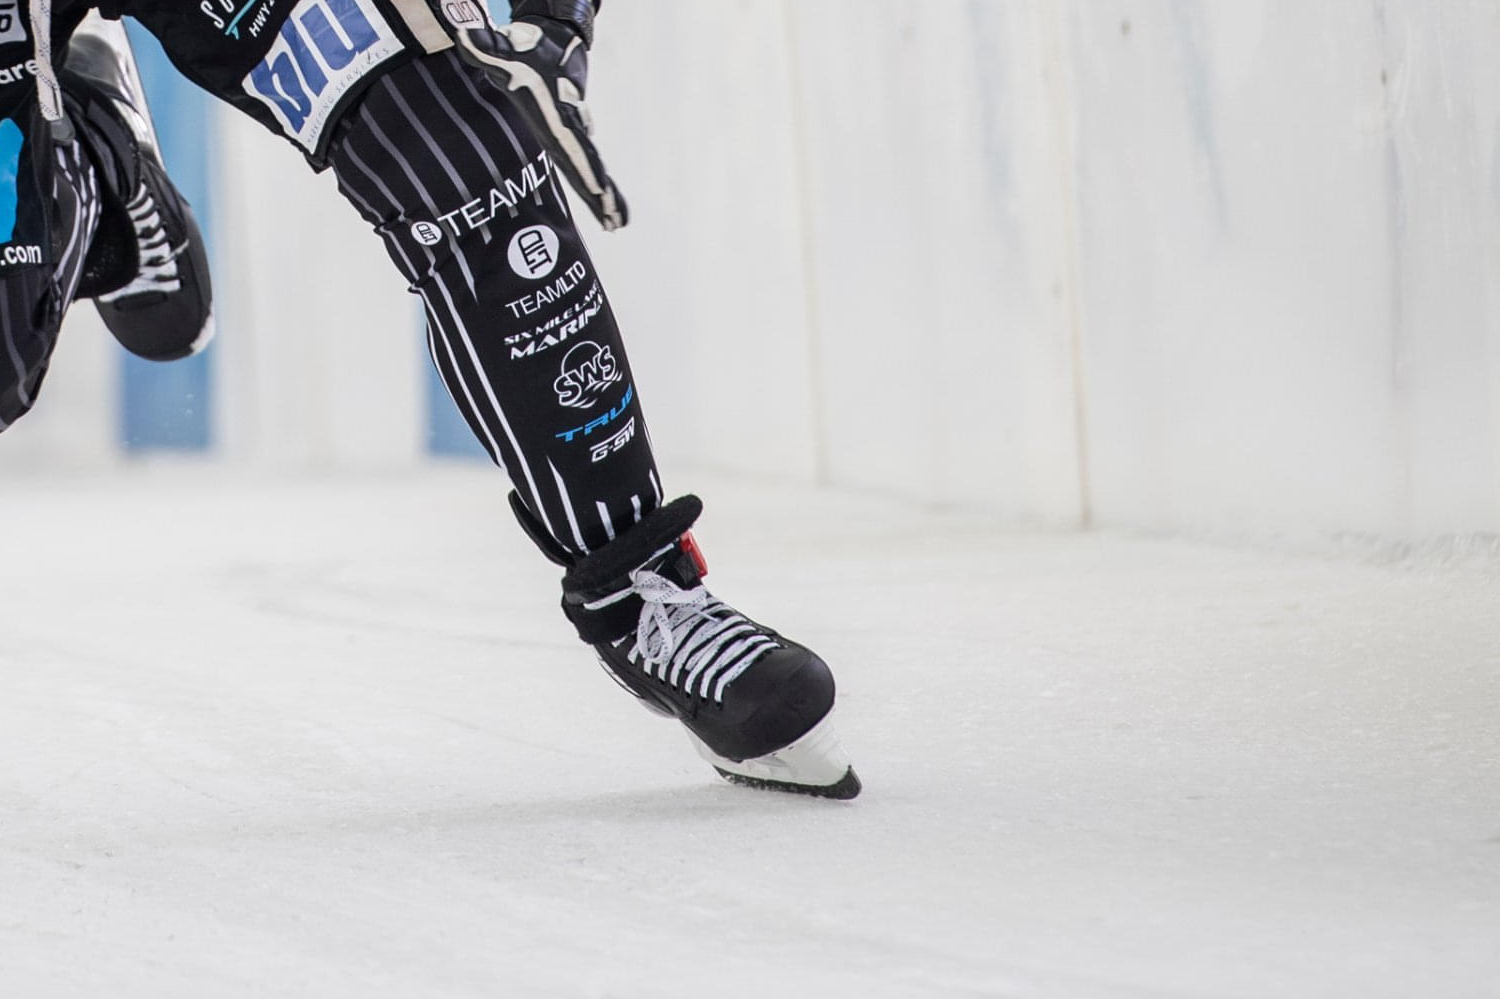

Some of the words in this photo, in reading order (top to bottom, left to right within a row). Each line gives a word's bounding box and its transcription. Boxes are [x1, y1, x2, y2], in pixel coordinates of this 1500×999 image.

[248, 2, 272, 38] HWY
[437, 150, 553, 238] TEAMLT
[504, 260, 587, 319] TEAMLTD
[554, 344, 617, 409] SWS
